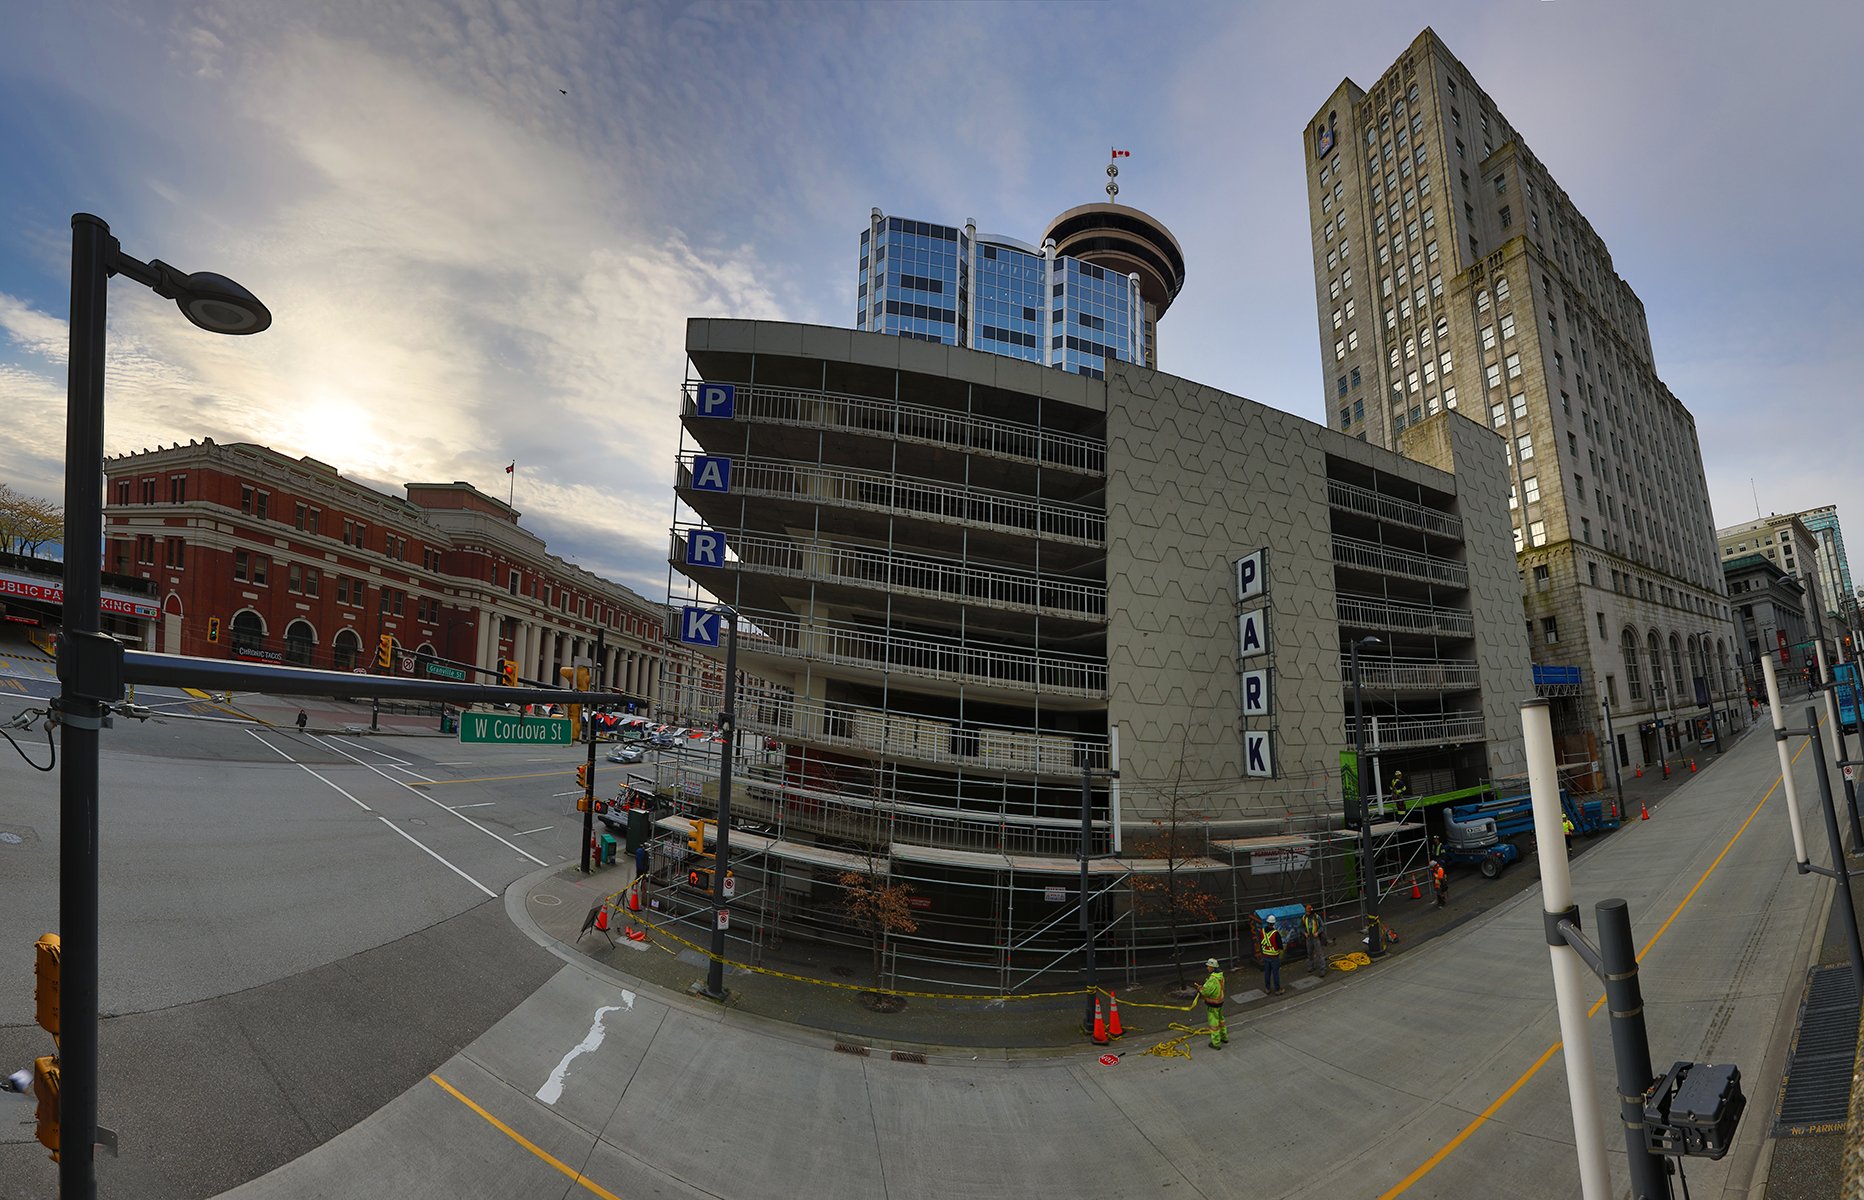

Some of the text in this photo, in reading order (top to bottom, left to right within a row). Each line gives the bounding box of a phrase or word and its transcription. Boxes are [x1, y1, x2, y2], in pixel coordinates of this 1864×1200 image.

[0, 581, 38, 596] UBLIC
[264, 651, 282, 660] TACOS
[429, 665, 463, 679] Granville St
[475, 718, 562, 740] W Cordova St
